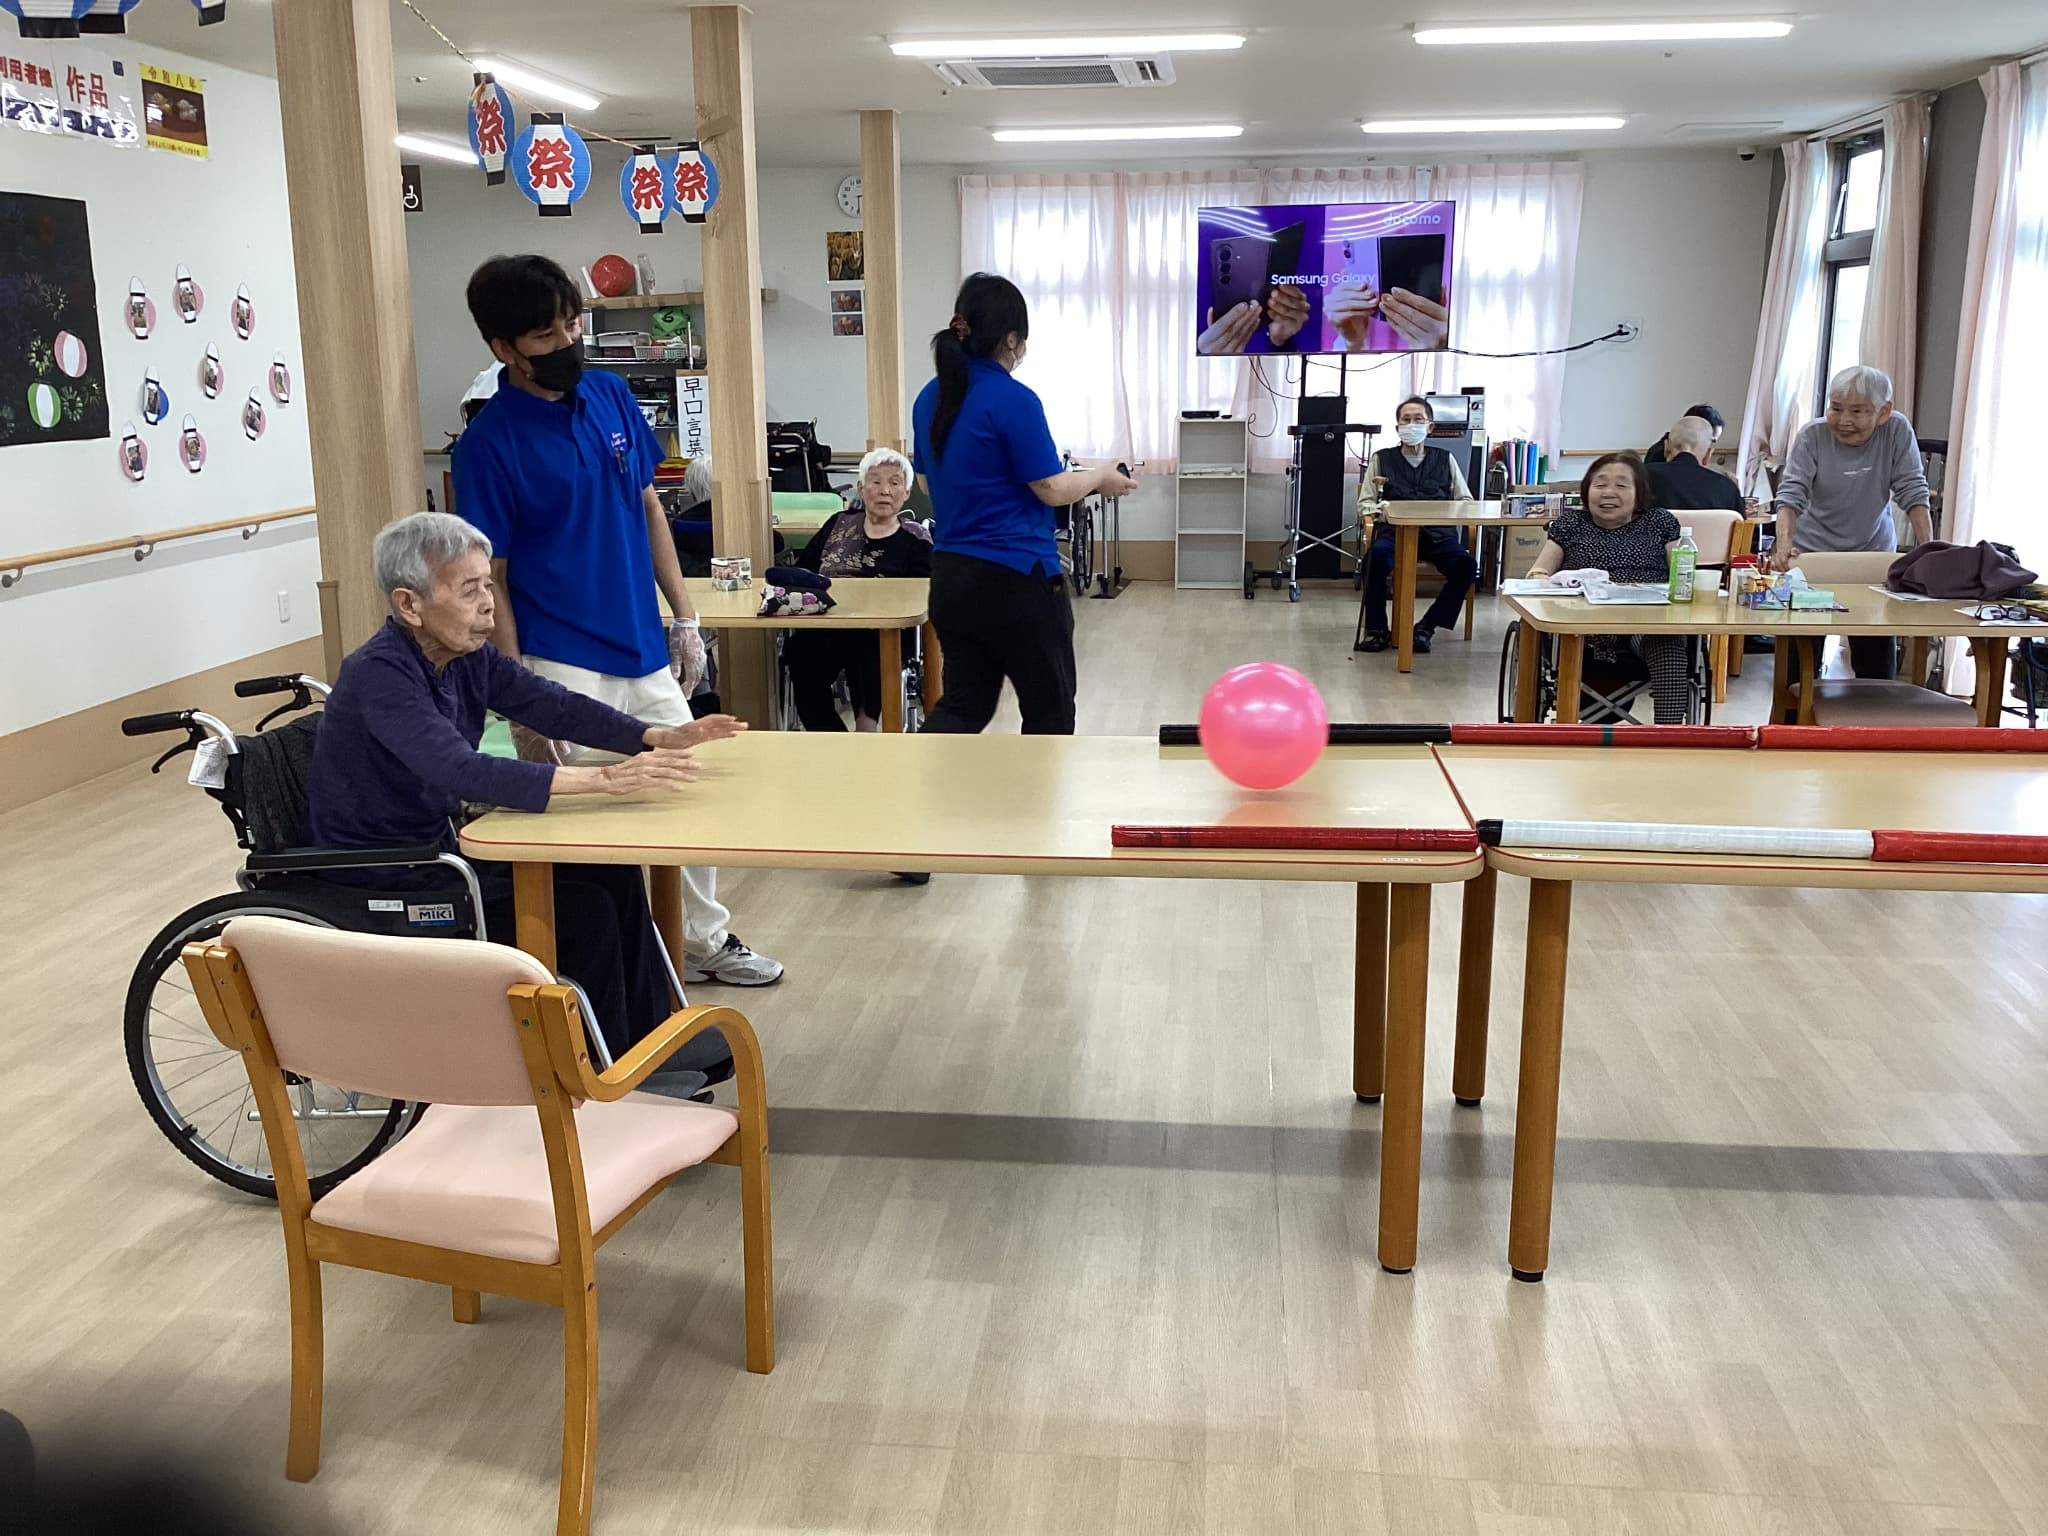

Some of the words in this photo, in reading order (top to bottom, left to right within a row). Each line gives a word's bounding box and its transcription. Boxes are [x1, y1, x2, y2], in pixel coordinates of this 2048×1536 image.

[66, 64, 109, 109] 作品
[475, 96, 506, 155] 祭
[528, 138, 574, 189] 祭
[675, 161, 708, 201] 祭
[632, 166, 663, 210] 祭
[1383, 212, 1441, 225] docomo
[1271, 274, 1329, 287] Samsung
[1331, 273, 1376, 286] Galaxy
[683, 377, 705, 457] 早口言葉
